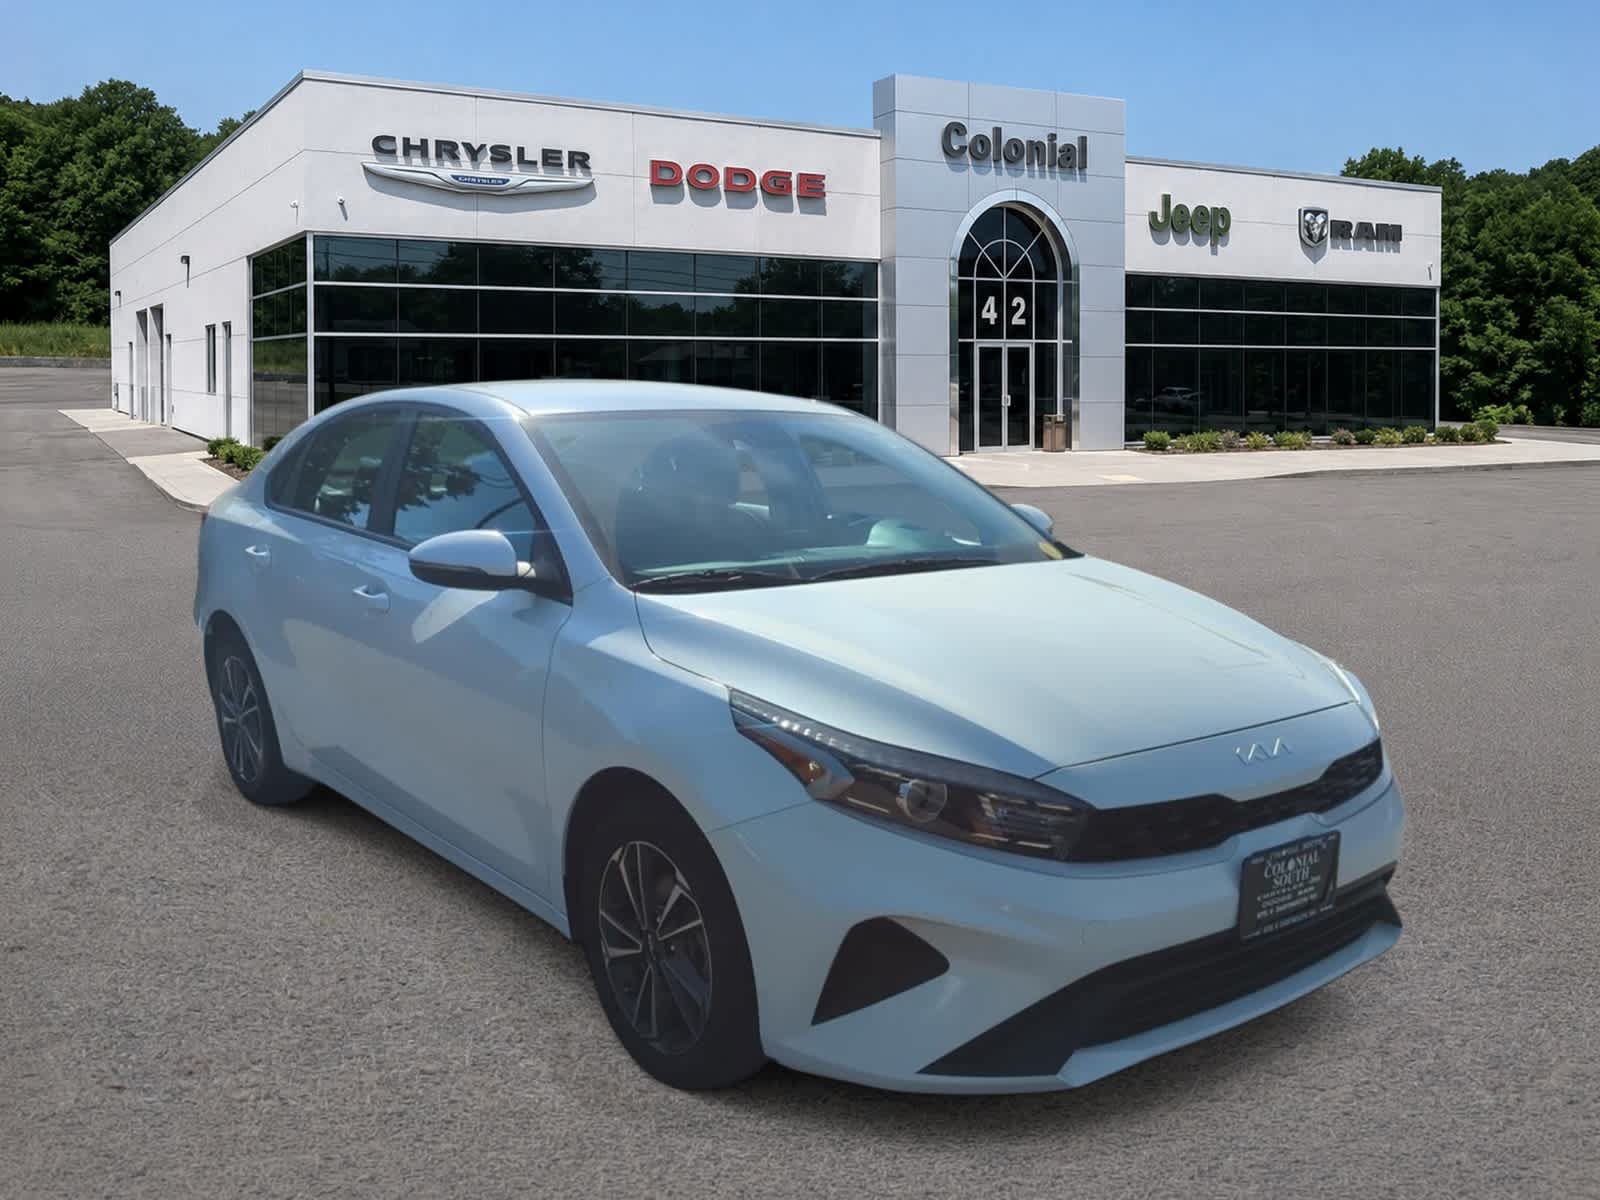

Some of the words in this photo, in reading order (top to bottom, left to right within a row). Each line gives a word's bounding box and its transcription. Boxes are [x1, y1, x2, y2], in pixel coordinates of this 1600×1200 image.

[371, 135, 592, 170] CHRYSLER
[942, 121, 1088, 169] Colonial
[649, 159, 827, 198] DODGE
[1149, 193, 1232, 244] Jeep
[1330, 219, 1403, 243] RAM
